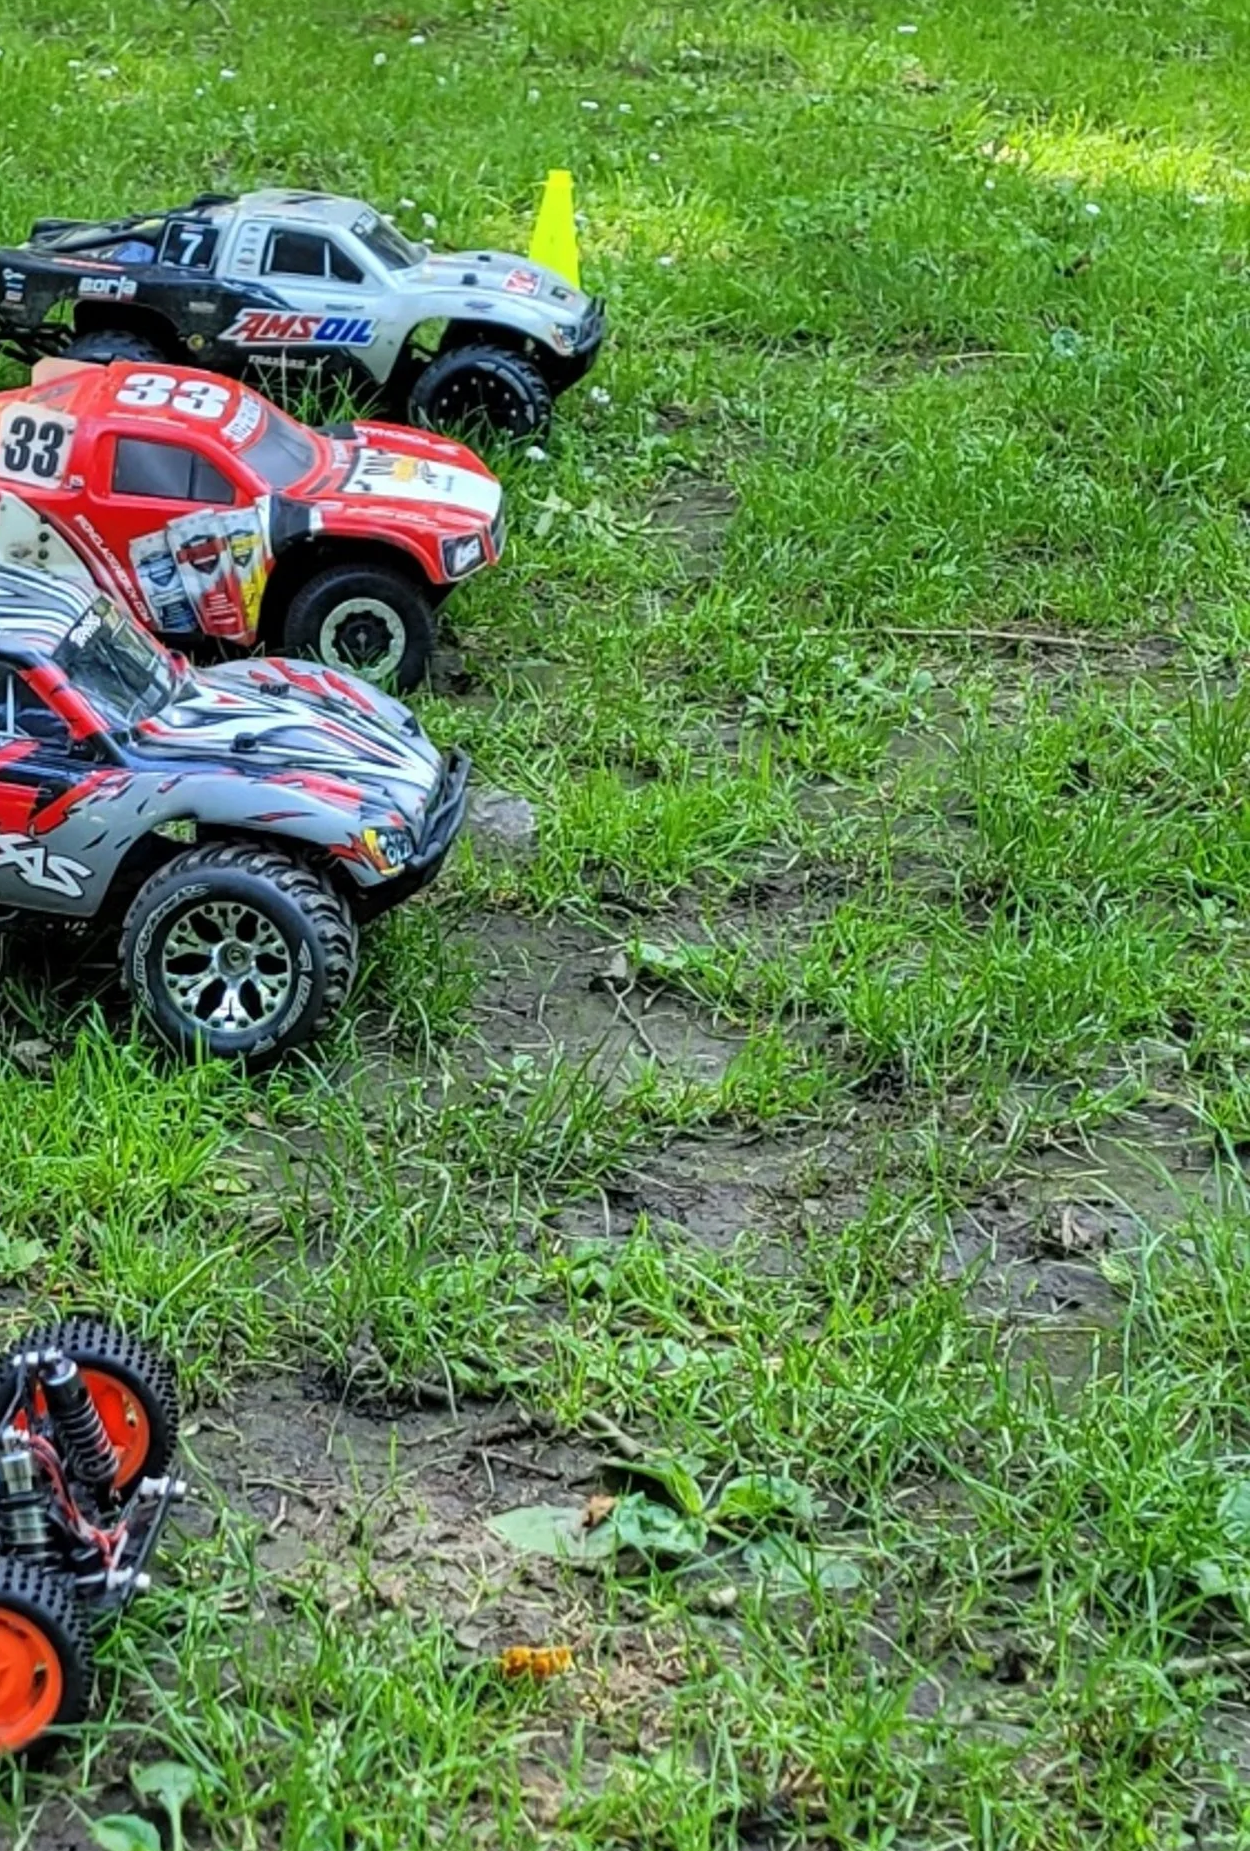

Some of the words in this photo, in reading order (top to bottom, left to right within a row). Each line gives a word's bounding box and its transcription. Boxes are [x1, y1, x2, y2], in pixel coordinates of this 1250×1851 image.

[180, 232, 204, 265] 7
[227, 310, 375, 344] AMSOIL
[114, 372, 231, 420] 33
[3, 414, 66, 478] 33
